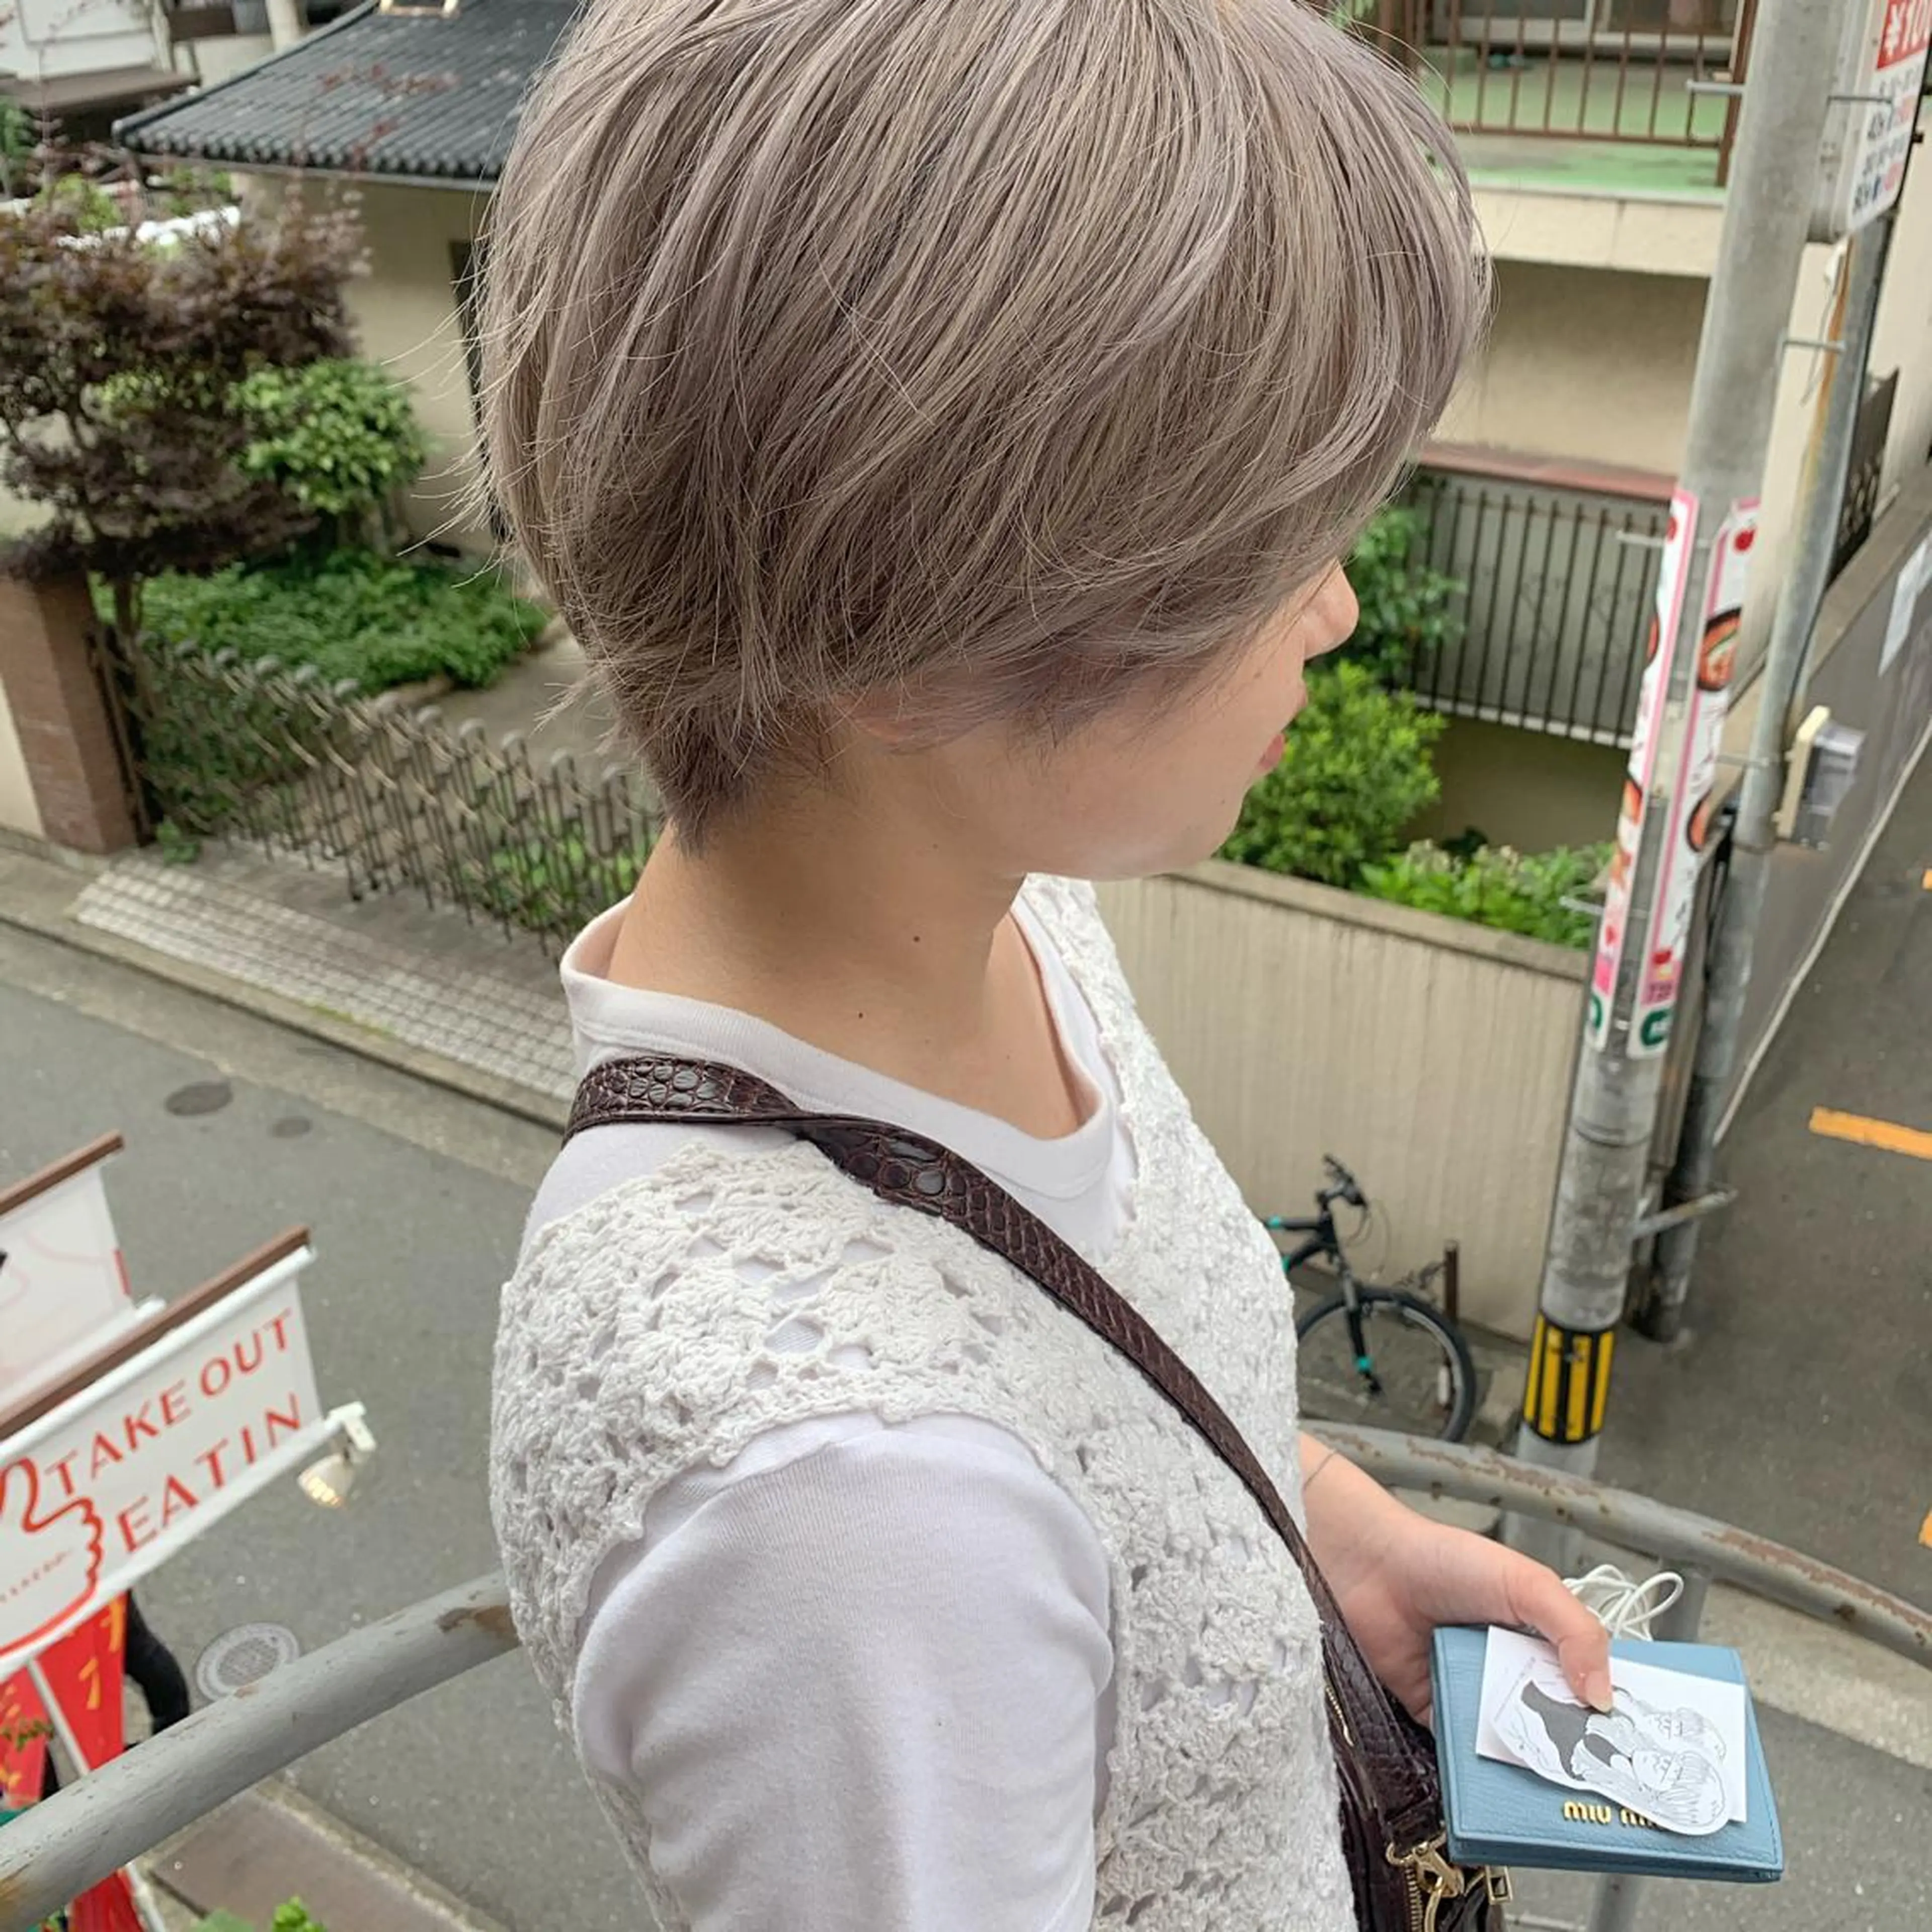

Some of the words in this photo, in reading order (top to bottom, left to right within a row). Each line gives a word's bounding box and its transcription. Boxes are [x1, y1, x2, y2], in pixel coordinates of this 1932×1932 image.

[44, 1379, 192, 1496] TAKE
[200, 1307, 293, 1398] OUT
[1563, 1800, 1611, 1824] miu
